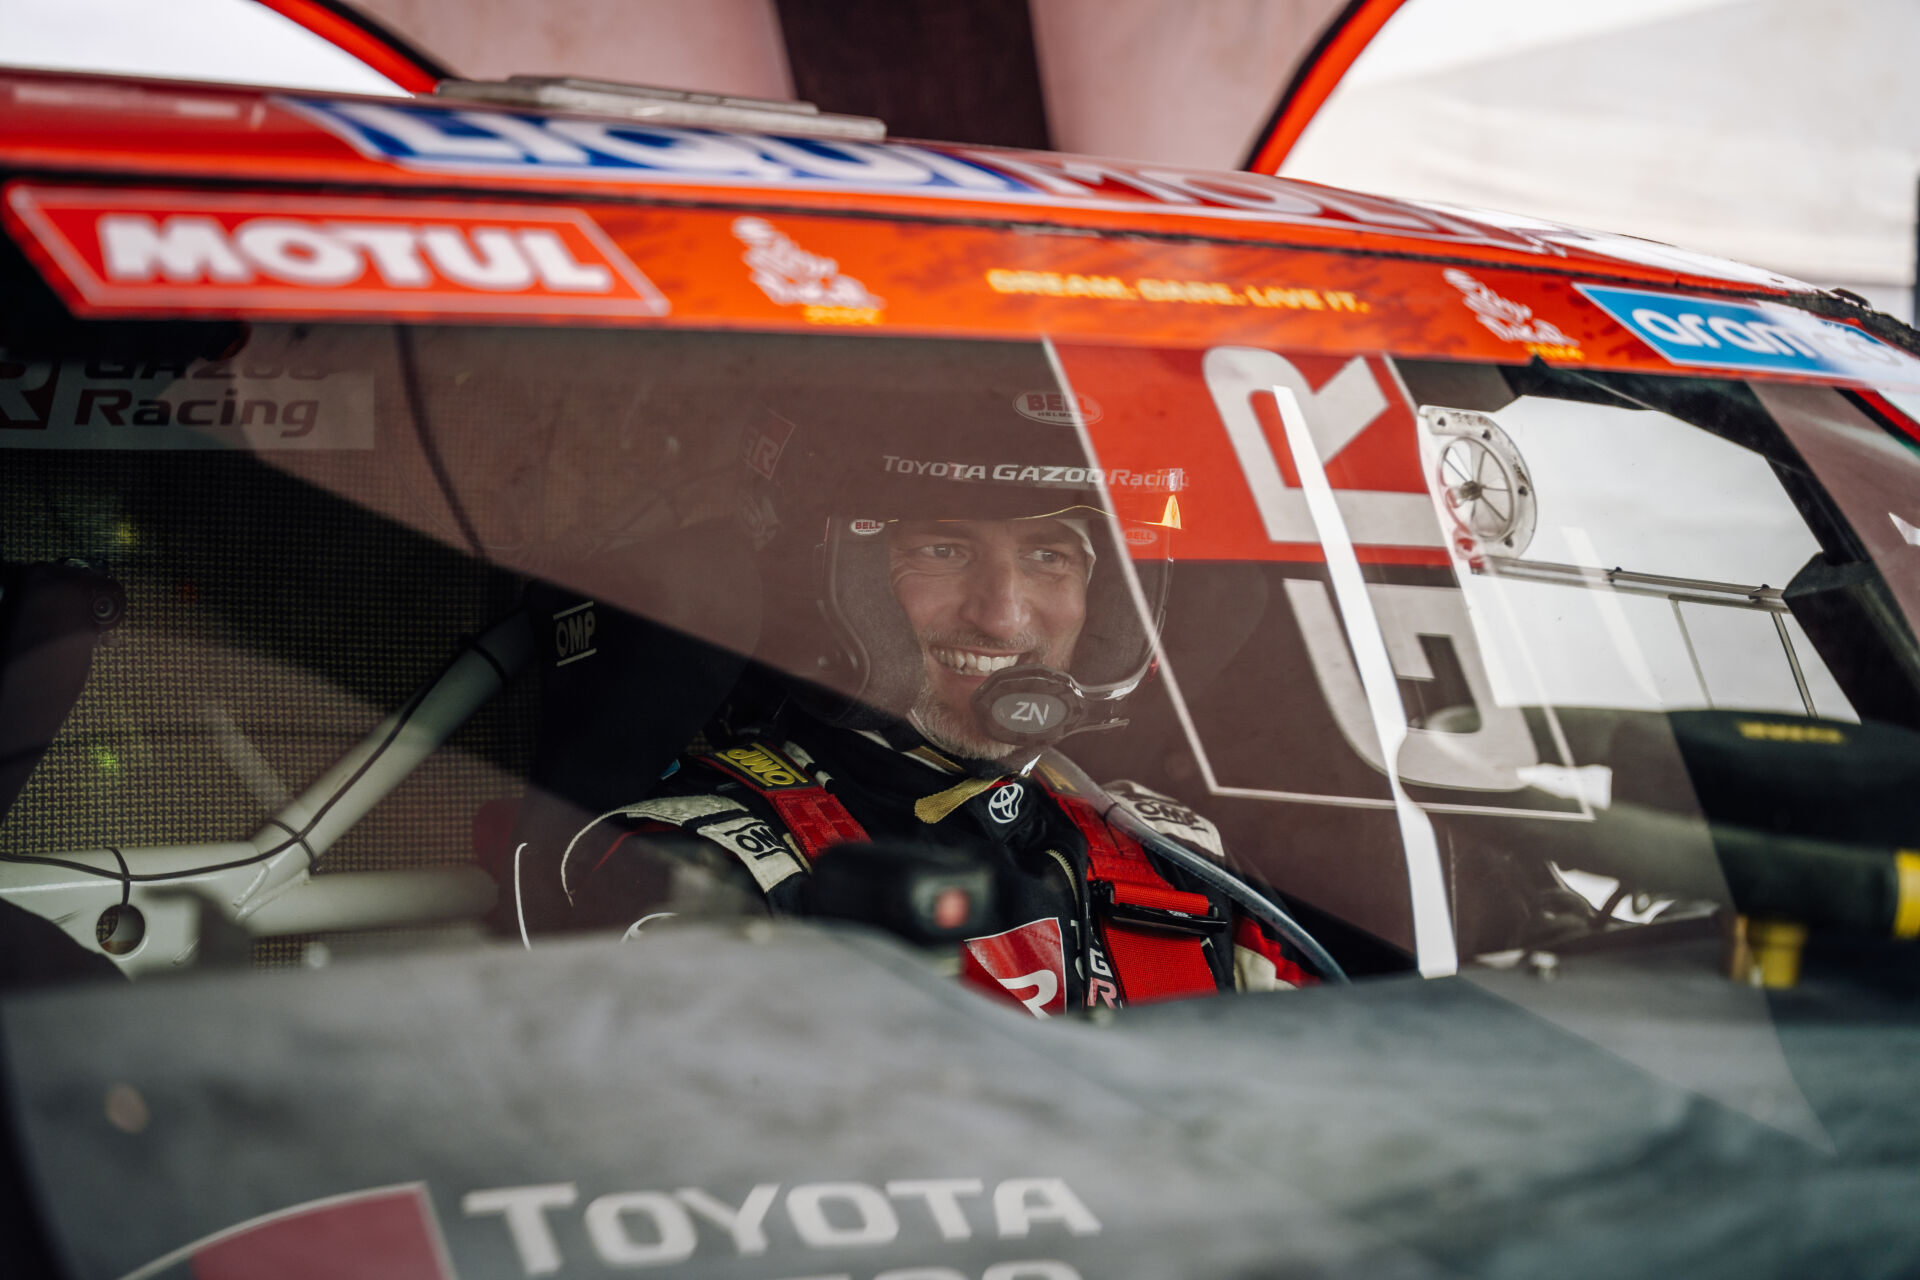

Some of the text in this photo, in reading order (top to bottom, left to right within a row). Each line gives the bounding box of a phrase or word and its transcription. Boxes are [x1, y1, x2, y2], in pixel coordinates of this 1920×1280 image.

[97, 213, 612, 291] MOTUL
[74, 388, 321, 438] Racing
[883, 456, 985, 481] TOYOTA
[992, 464, 1104, 484] GAZOO
[855, 521, 881, 530] BELL
[556, 611, 595, 657] OMP
[726, 748, 796, 785] OMP
[462, 1177, 1101, 1276] TOYOTA
